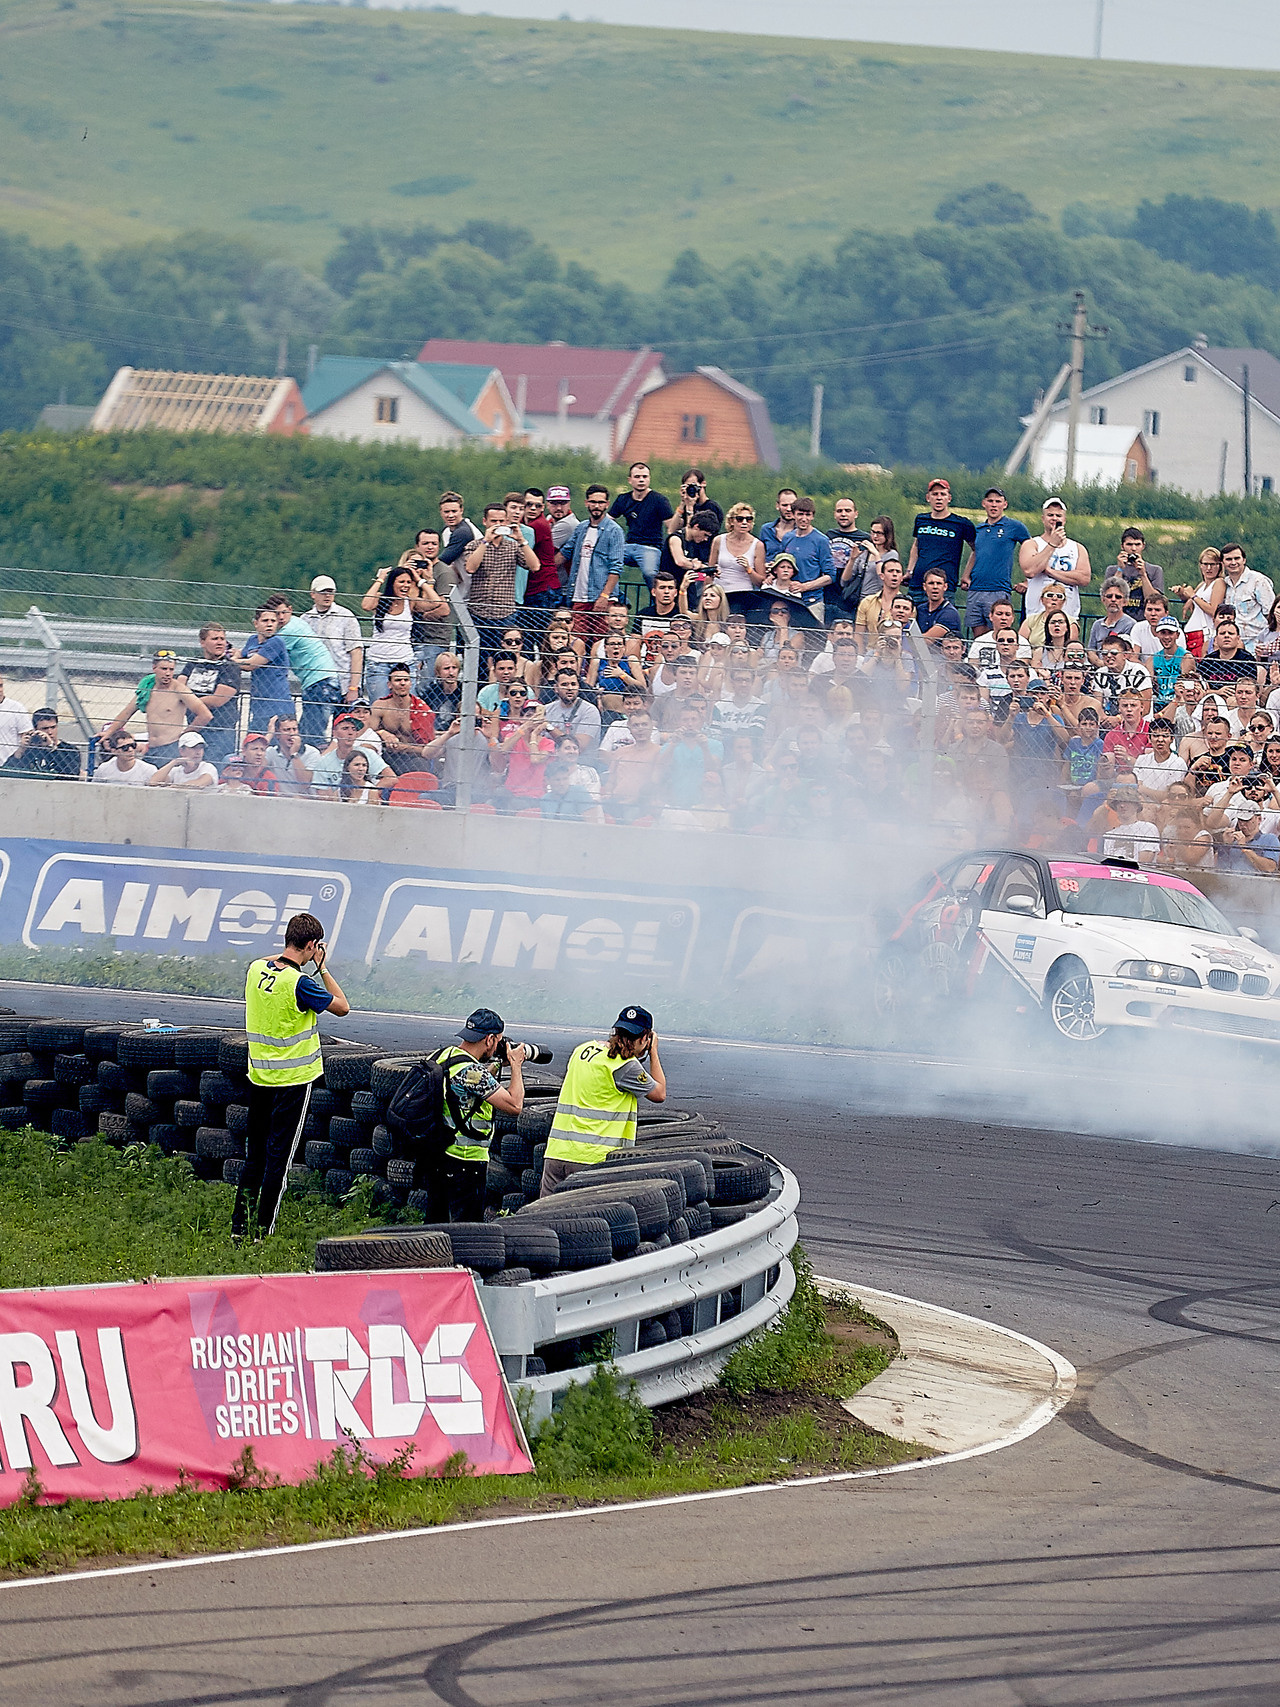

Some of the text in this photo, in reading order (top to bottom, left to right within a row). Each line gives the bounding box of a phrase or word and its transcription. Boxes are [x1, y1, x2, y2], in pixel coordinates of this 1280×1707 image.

[918, 526, 949, 537] adidas
[1110, 870, 1149, 883] RDS
[384, 903, 673, 978] AIMOL
[257, 971, 276, 993] 72
[580, 1045, 604, 1063] 67
[190, 1331, 295, 1370] RUSSIAN
[0, 1326, 140, 1471] RU
[225, 1365, 296, 1404] DRIFT
[304, 1322, 486, 1440] RDS
[216, 1400, 300, 1439] SERIES
